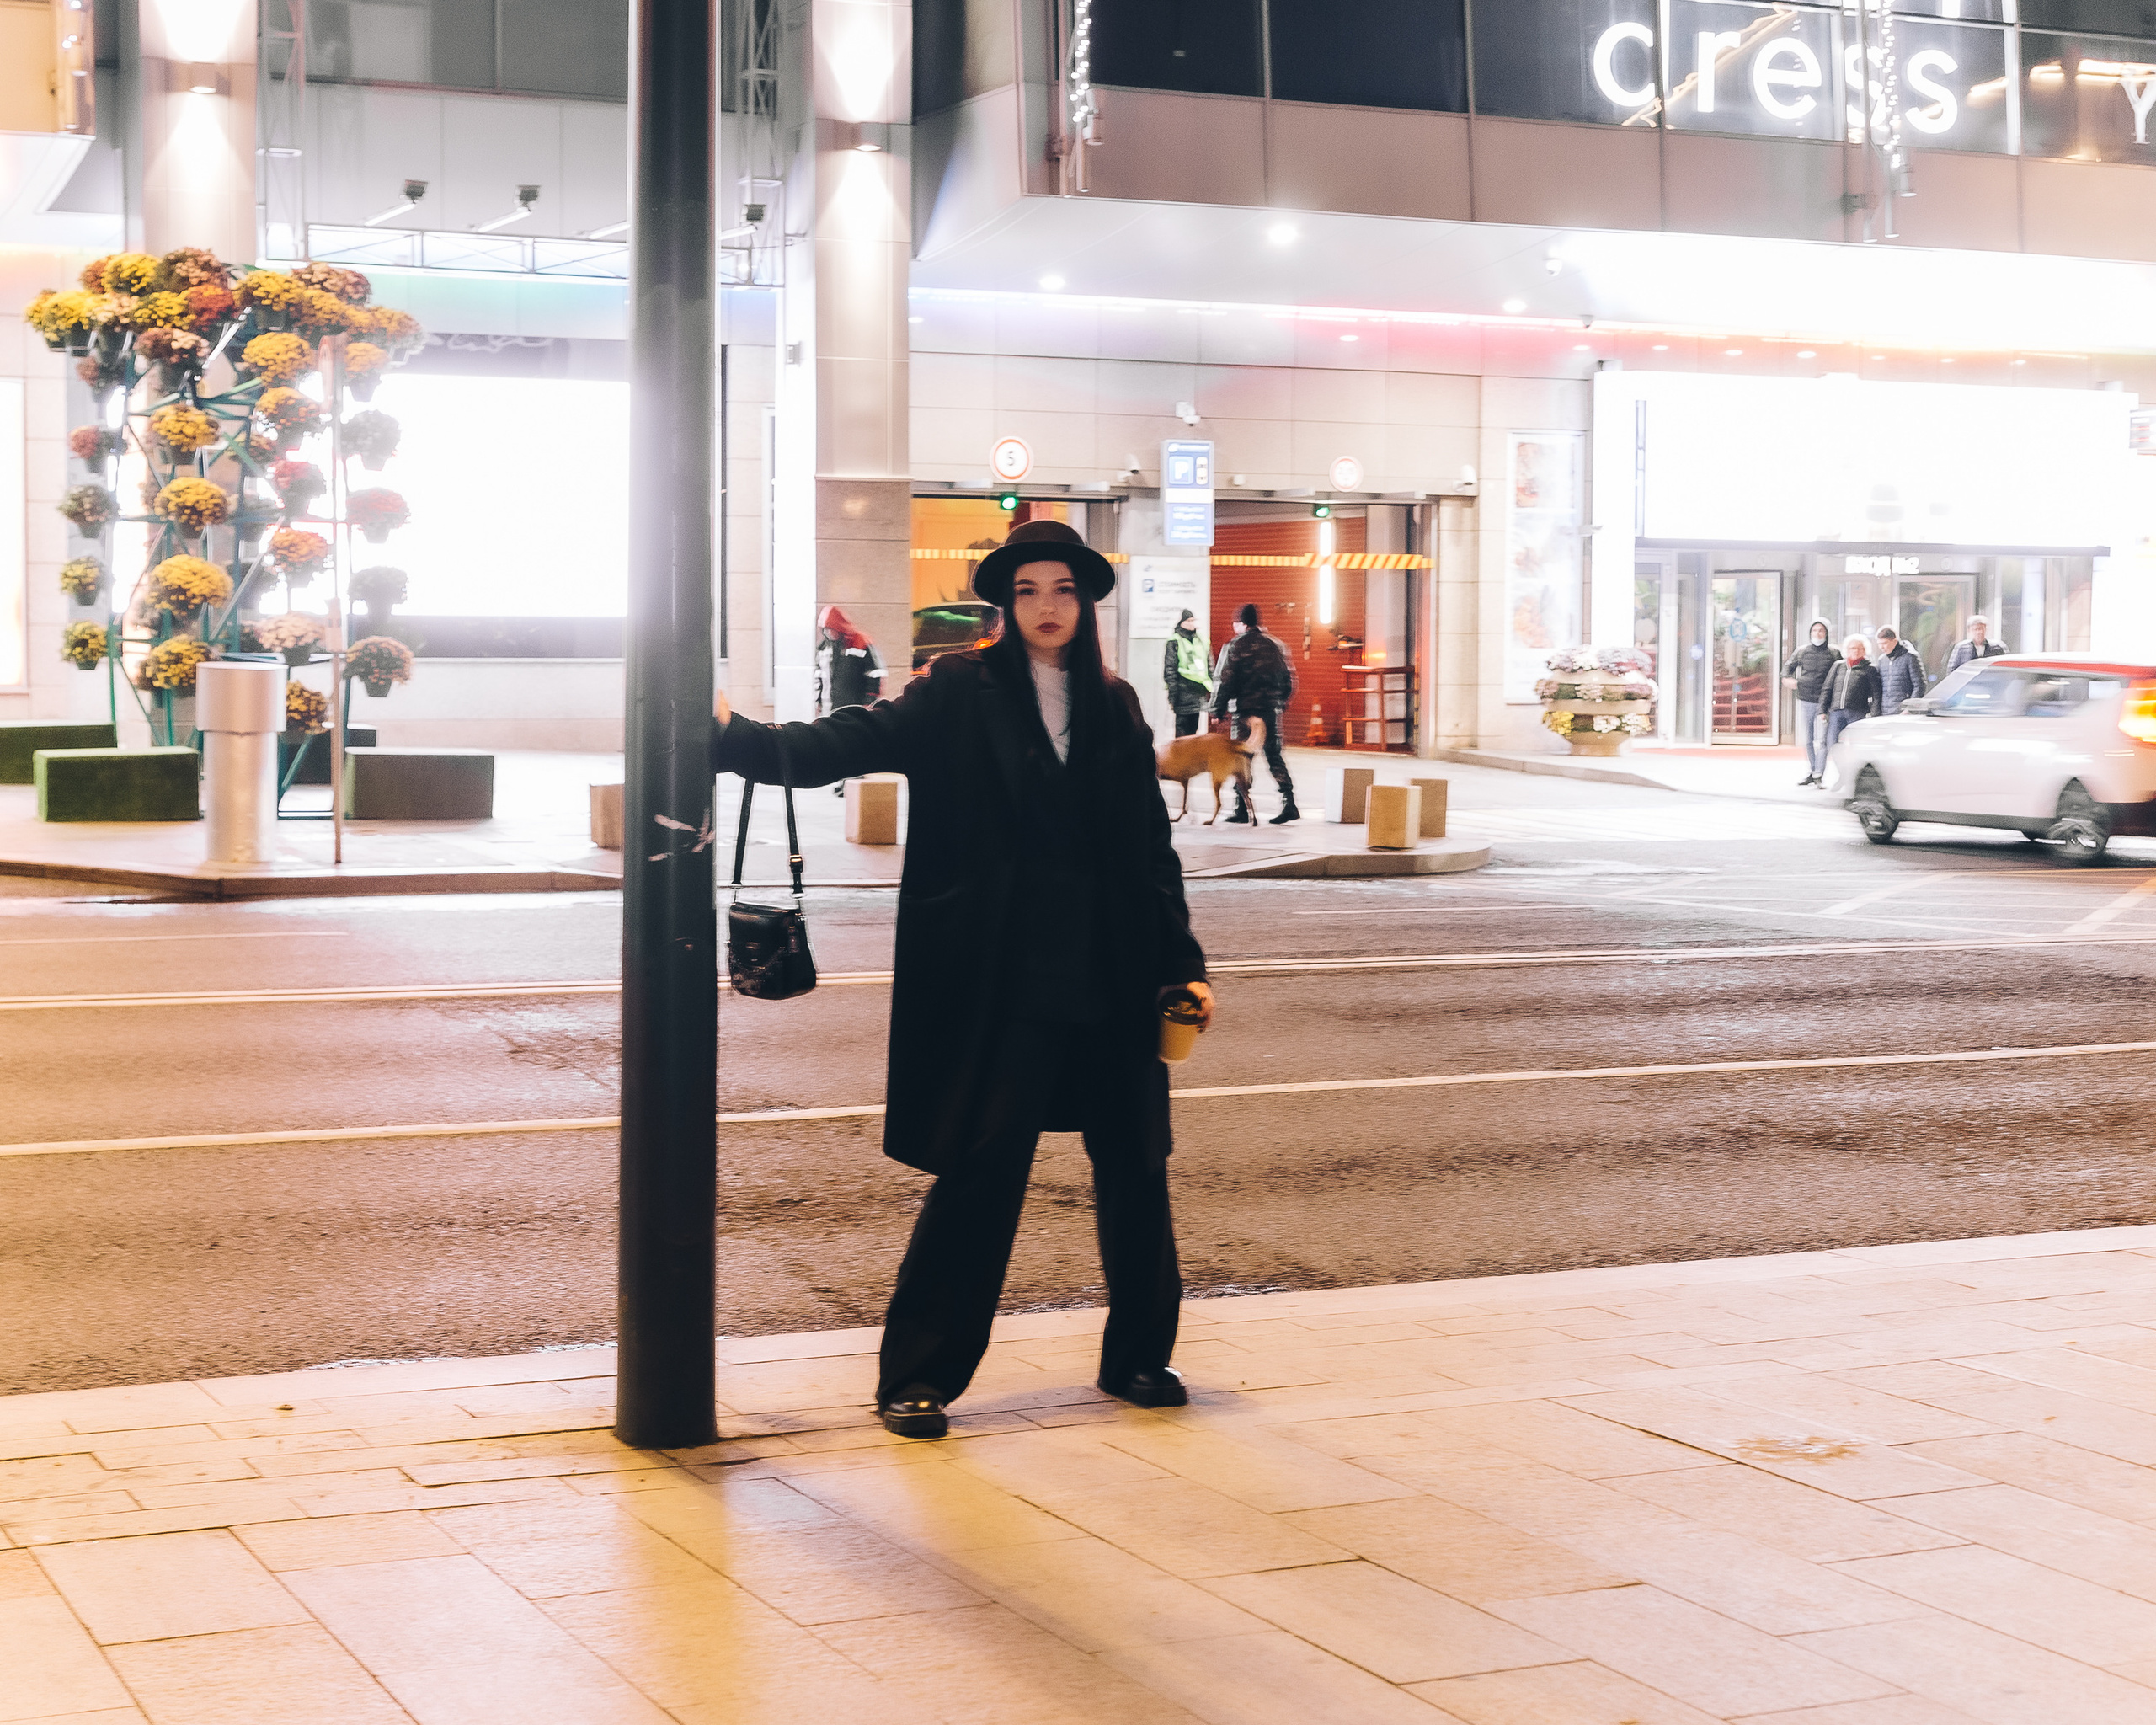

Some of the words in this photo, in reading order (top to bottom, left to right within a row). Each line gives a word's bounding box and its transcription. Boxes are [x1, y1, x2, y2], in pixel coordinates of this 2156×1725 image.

[1593, 22, 1958, 134] cress
[1006, 451, 1016, 467] 5
[1175, 461, 1189, 480] P
